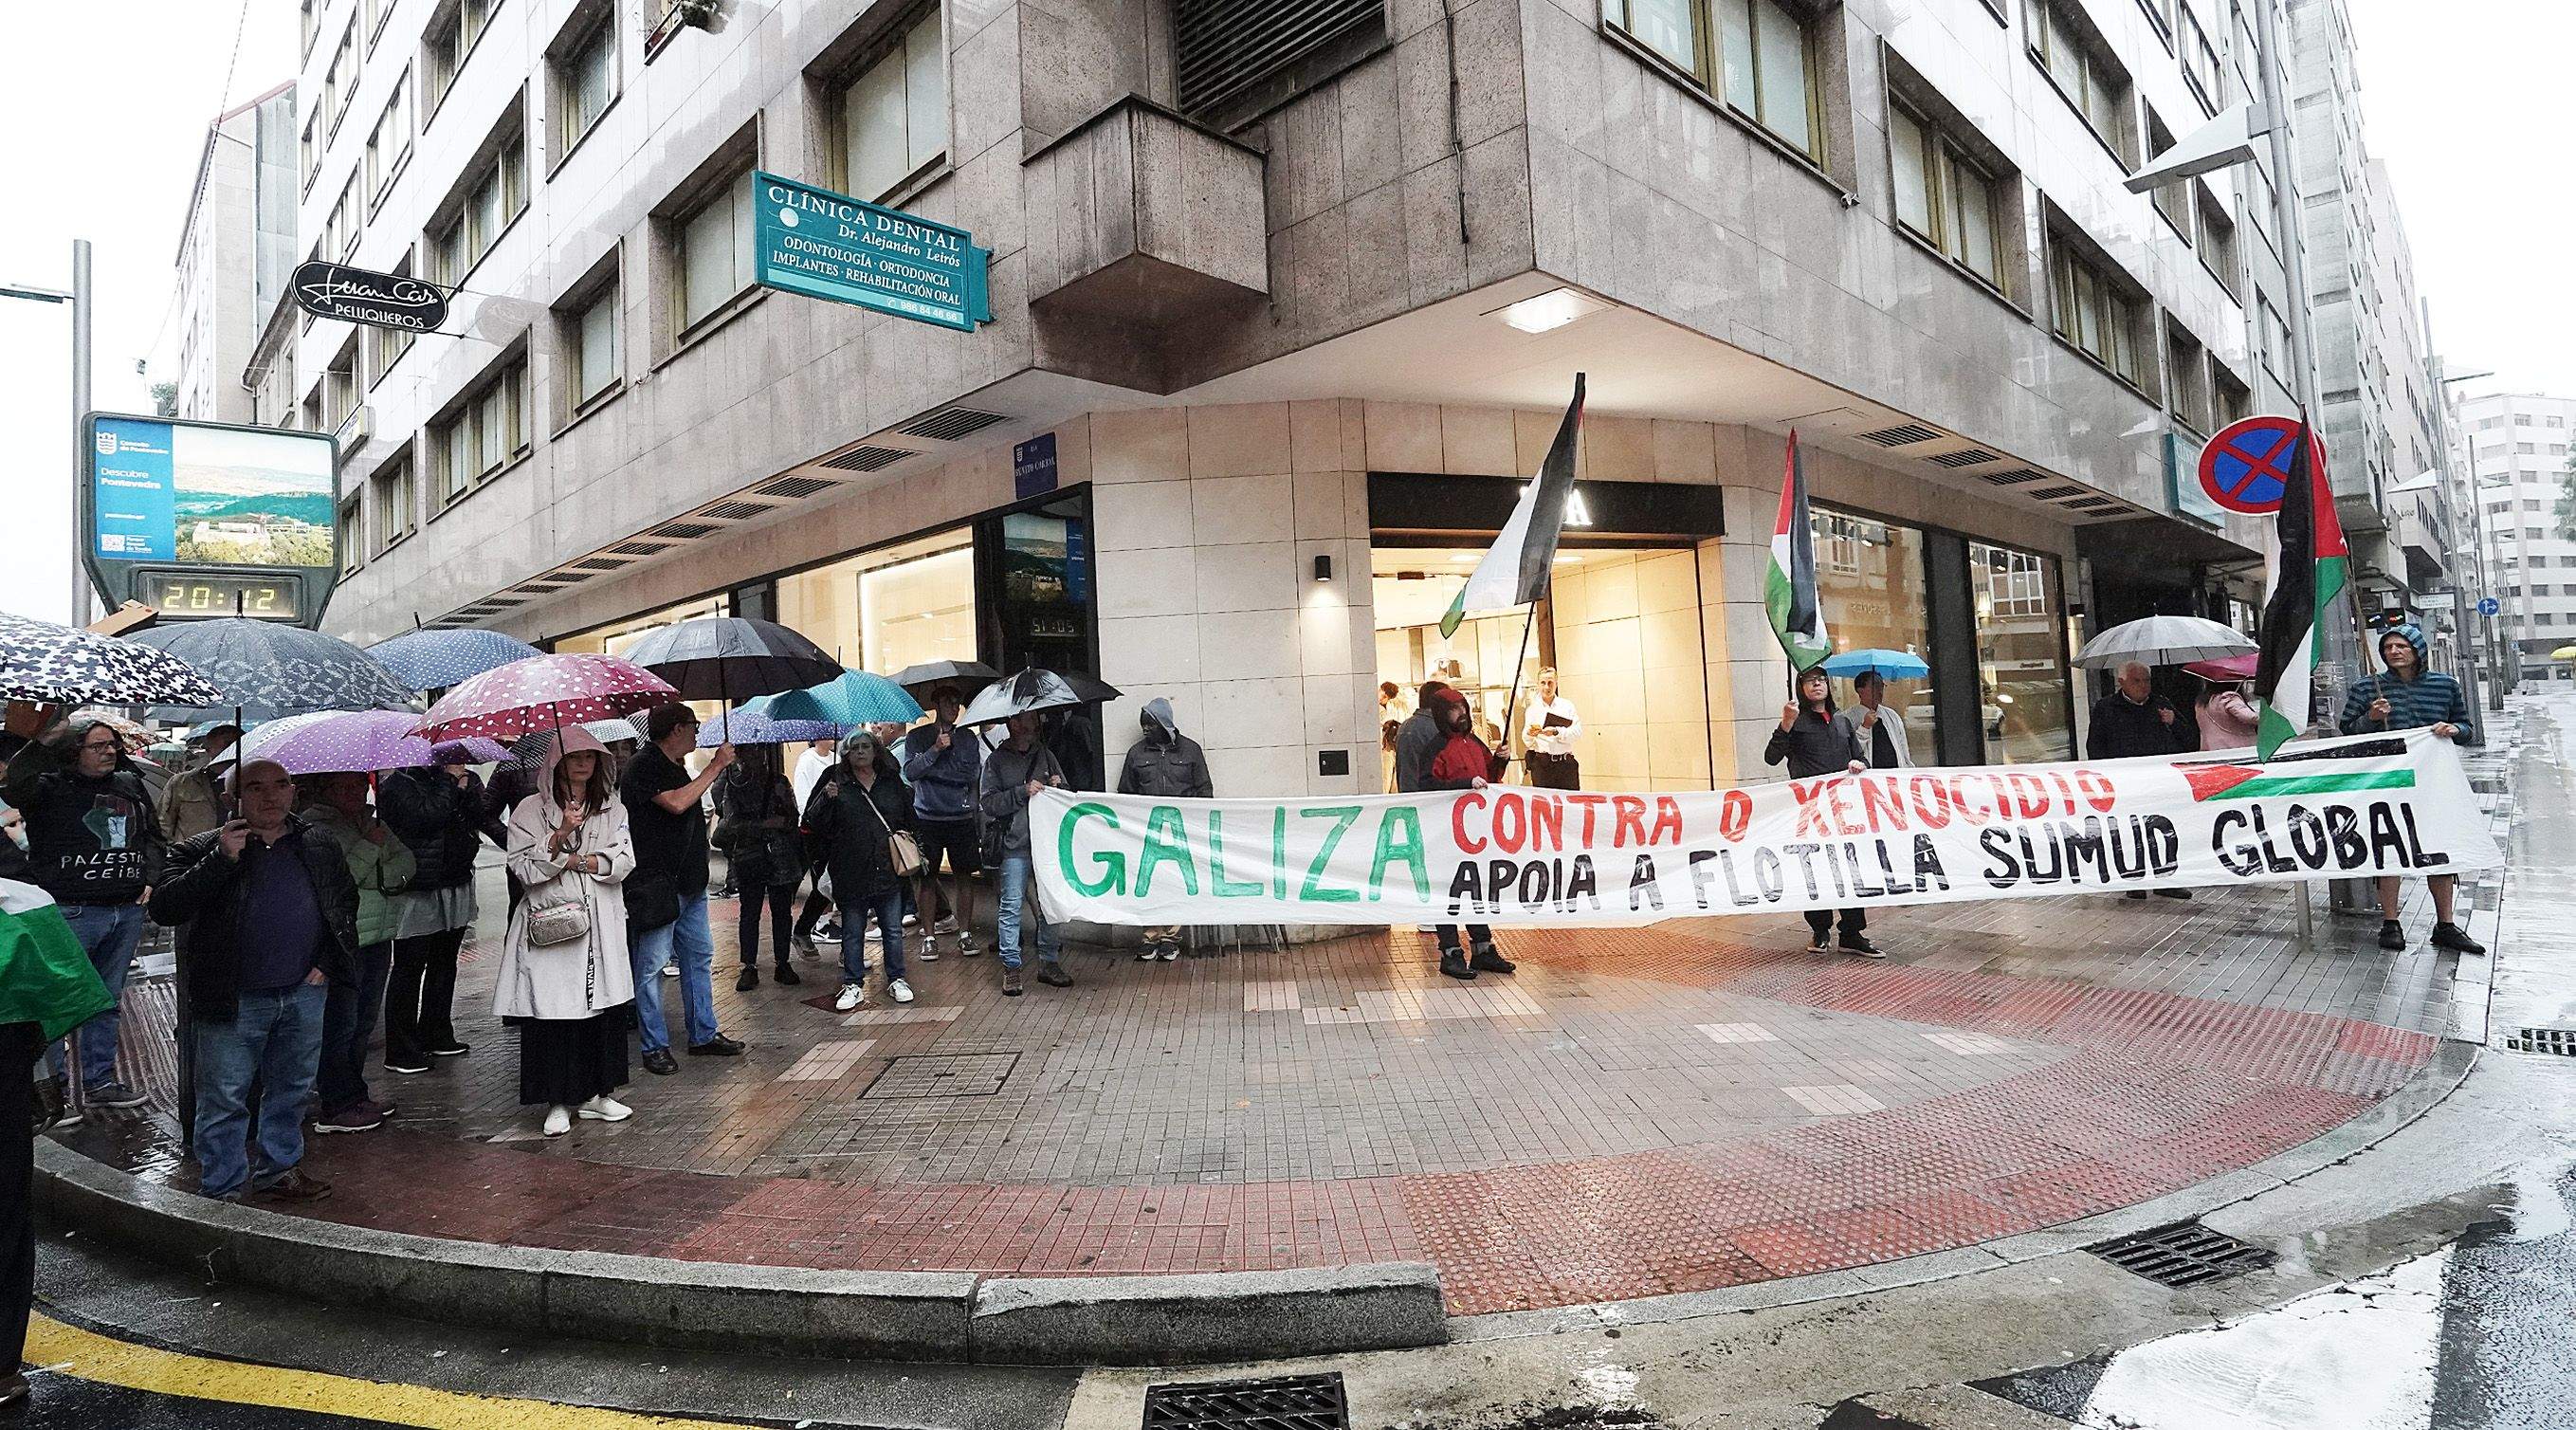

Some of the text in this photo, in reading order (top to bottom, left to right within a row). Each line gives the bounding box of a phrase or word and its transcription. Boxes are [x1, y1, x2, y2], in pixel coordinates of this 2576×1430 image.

[768, 186, 960, 252] CLÍNICA DENTAL
[783, 236, 950, 288] ODONTOLOGÍA ORTODONCIA
[838, 224, 961, 267] Dr. Alejandro Leirós
[773, 249, 961, 306] IMPLANTES REHABILITACIÓN ORAL
[335, 302, 425, 329] PELUQUEROS
[900, 301, 919, 314] 986
[100, 467, 150, 479] Descubre
[100, 477, 162, 490] Pontevedra
[163, 585, 276, 612] 20:12
[1058, 769, 2116, 904] GALIZA CONTRA O XENOCIDIO
[1447, 801, 2450, 916] APOIA A FLOTILLA SUMUD GLOBAL
